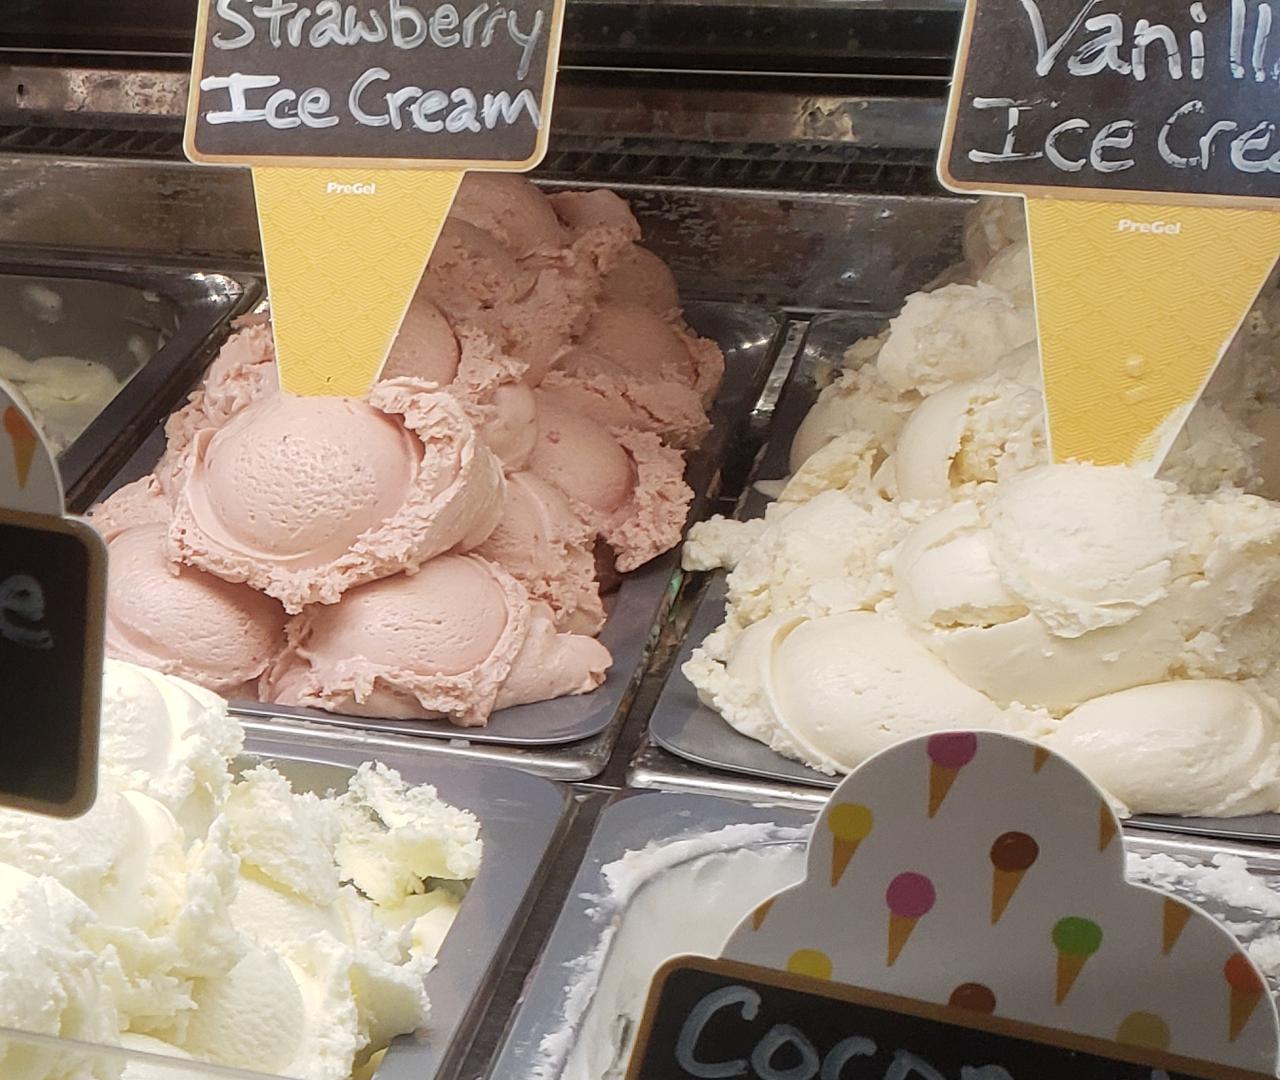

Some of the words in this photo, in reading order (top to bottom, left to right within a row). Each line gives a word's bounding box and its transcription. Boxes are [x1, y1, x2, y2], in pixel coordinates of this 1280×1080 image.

[212, 0, 543, 80] Strawberry
[1021, 0, 1280, 82] Vanill
[199, 73, 339, 129] Ice
[348, 67, 543, 132] Cream
[968, 97, 1138, 172] Ice
[1157, 100, 1280, 174] Cre
[326, 182, 376, 195] PreGel
[1118, 218, 1182, 235] PreGel
